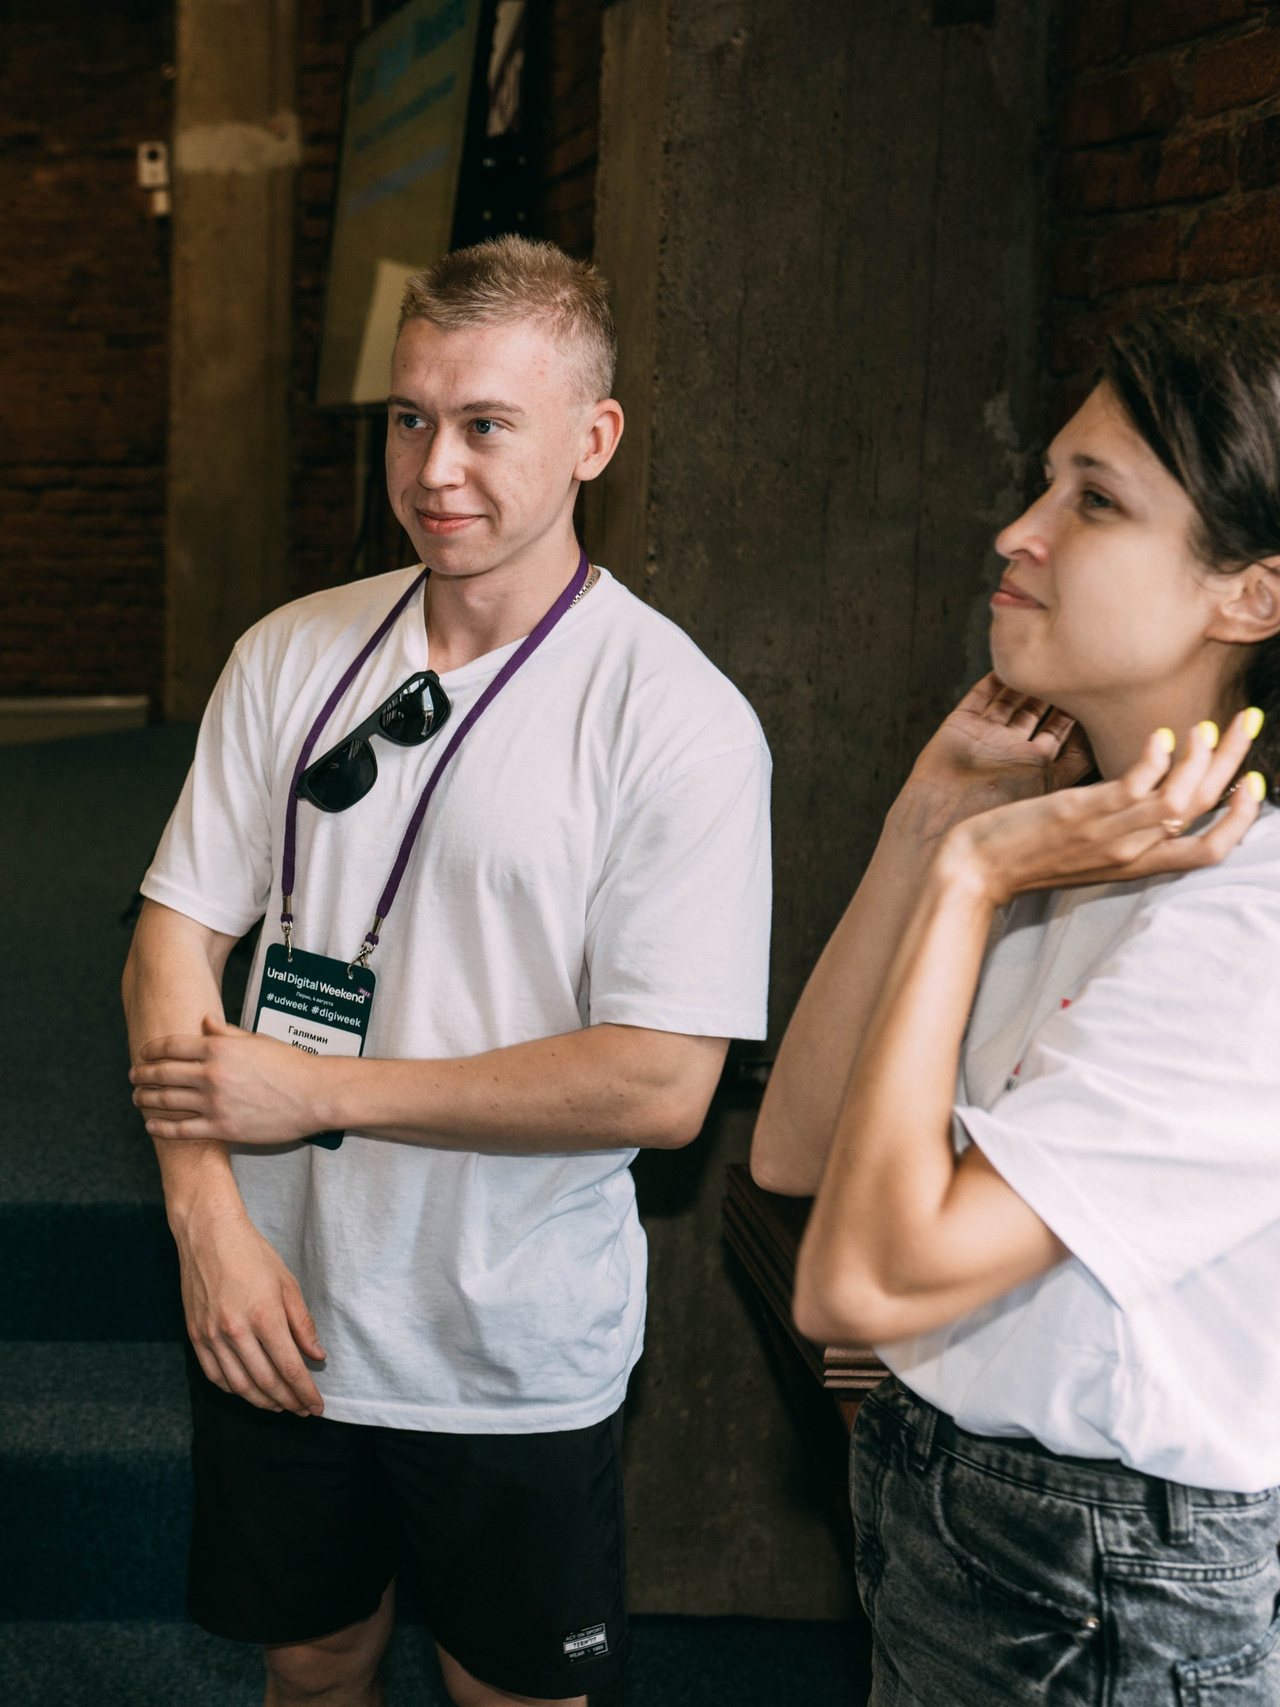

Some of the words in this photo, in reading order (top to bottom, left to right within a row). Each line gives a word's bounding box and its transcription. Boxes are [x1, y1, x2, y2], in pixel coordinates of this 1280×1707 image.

[267, 967, 287, 982] Ural
[287, 973, 319, 989] Digital
[320, 982, 365, 1004] Weekend
[266, 993, 308, 1012] #udweek
[311, 1005, 362, 1027] #digiweek
[288, 1025, 328, 1044] Галямин
